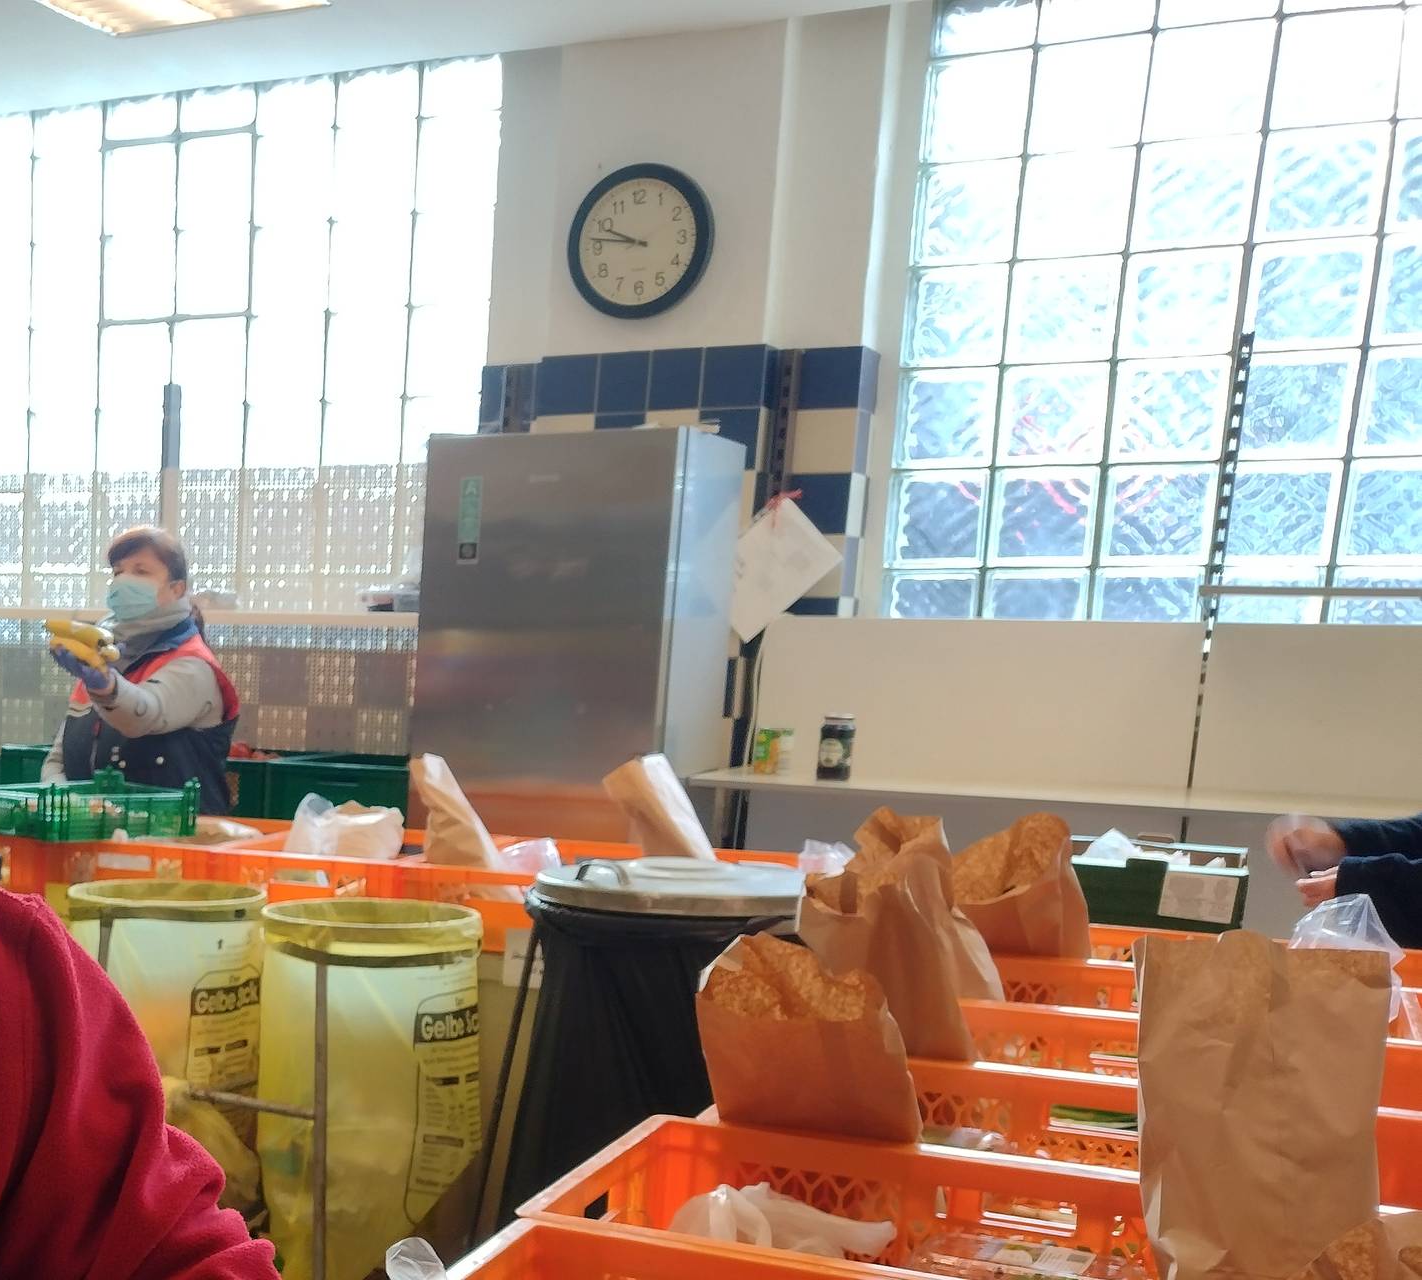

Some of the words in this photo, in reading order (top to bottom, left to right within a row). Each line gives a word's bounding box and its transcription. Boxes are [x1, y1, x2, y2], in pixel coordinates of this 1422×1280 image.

[632, 188, 647, 205] 12
[658, 192, 664, 206] 1
[612, 200, 625, 215] 11
[672, 206, 682, 222] 2
[597, 217, 614, 232] 10
[676, 229, 687, 245] 3
[592, 240, 603, 256] 9
[670, 253, 681, 267] 4
[598, 263, 609, 278] 8
[615, 277, 624, 292] 7
[655, 272, 665, 287] 5
[633, 280, 644, 296] 6
[421, 1013, 464, 1041] Gelbe
